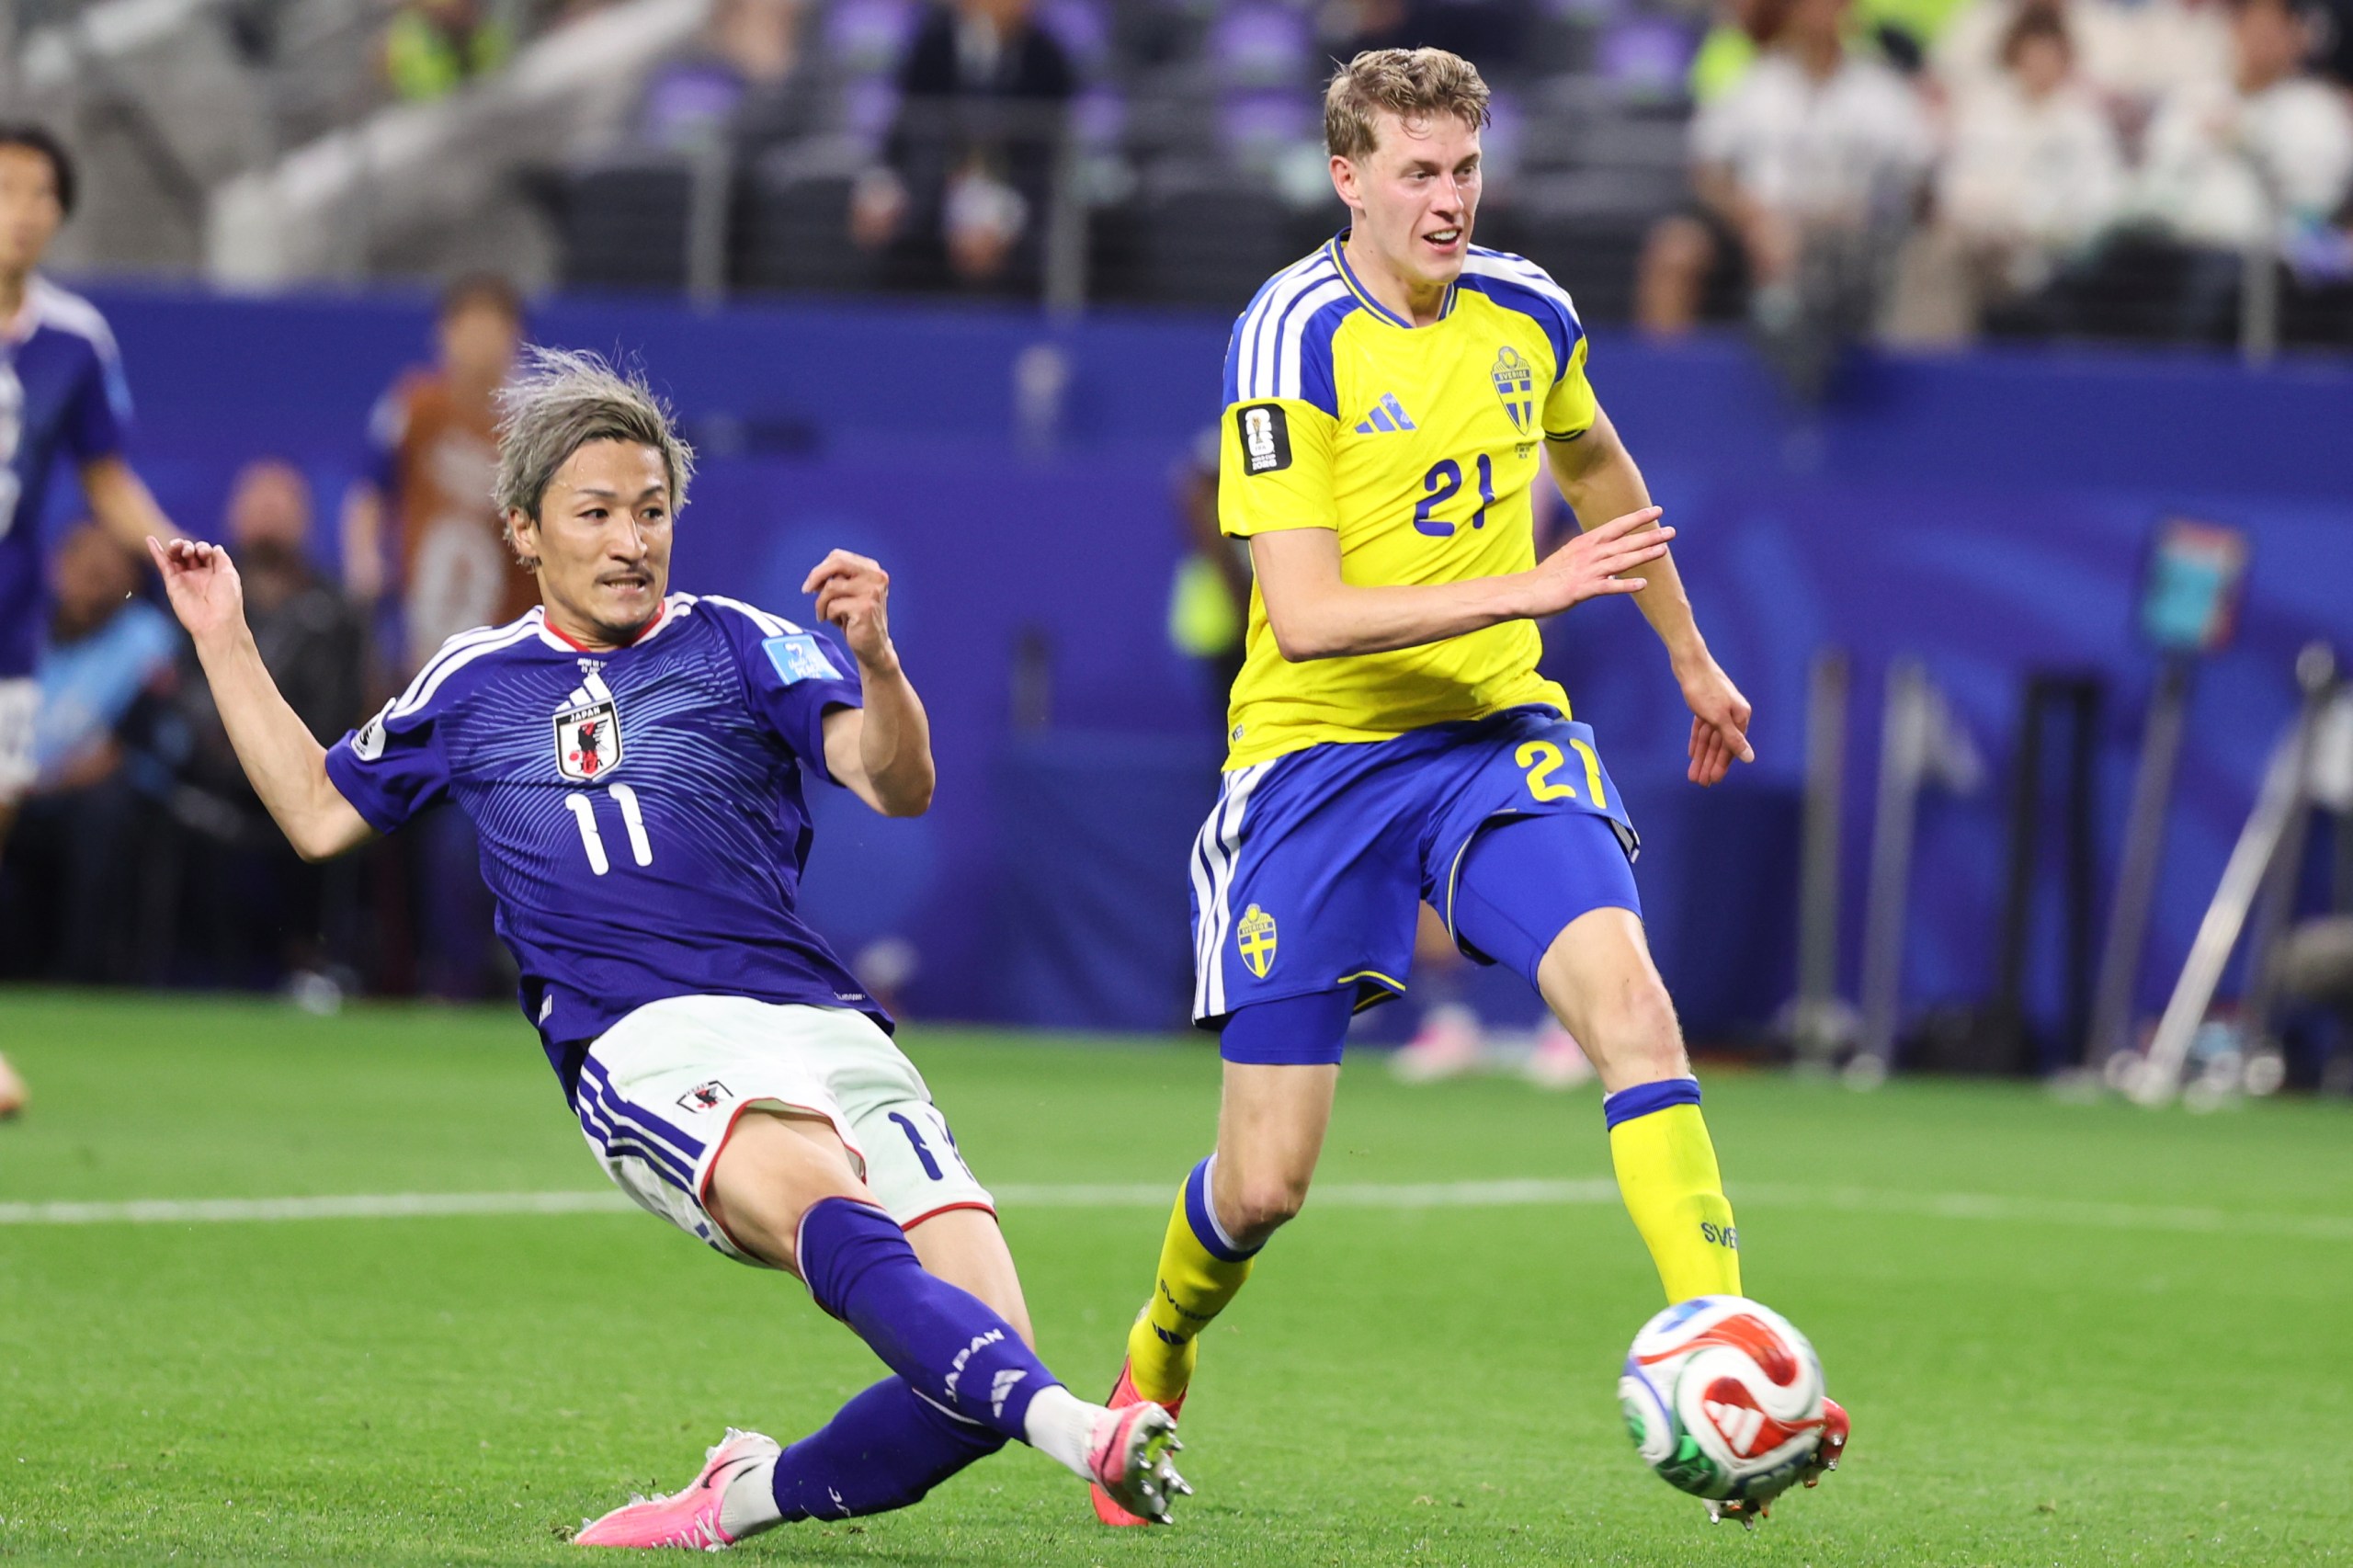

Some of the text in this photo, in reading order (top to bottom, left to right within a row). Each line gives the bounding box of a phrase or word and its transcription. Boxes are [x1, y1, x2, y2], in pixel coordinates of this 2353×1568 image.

[1413, 453, 1496, 537] 21
[570, 706, 601, 722] JAPAN
[1515, 738, 1608, 810] 21
[565, 783, 654, 876] 11
[945, 1328, 1005, 1403] JAPAN
